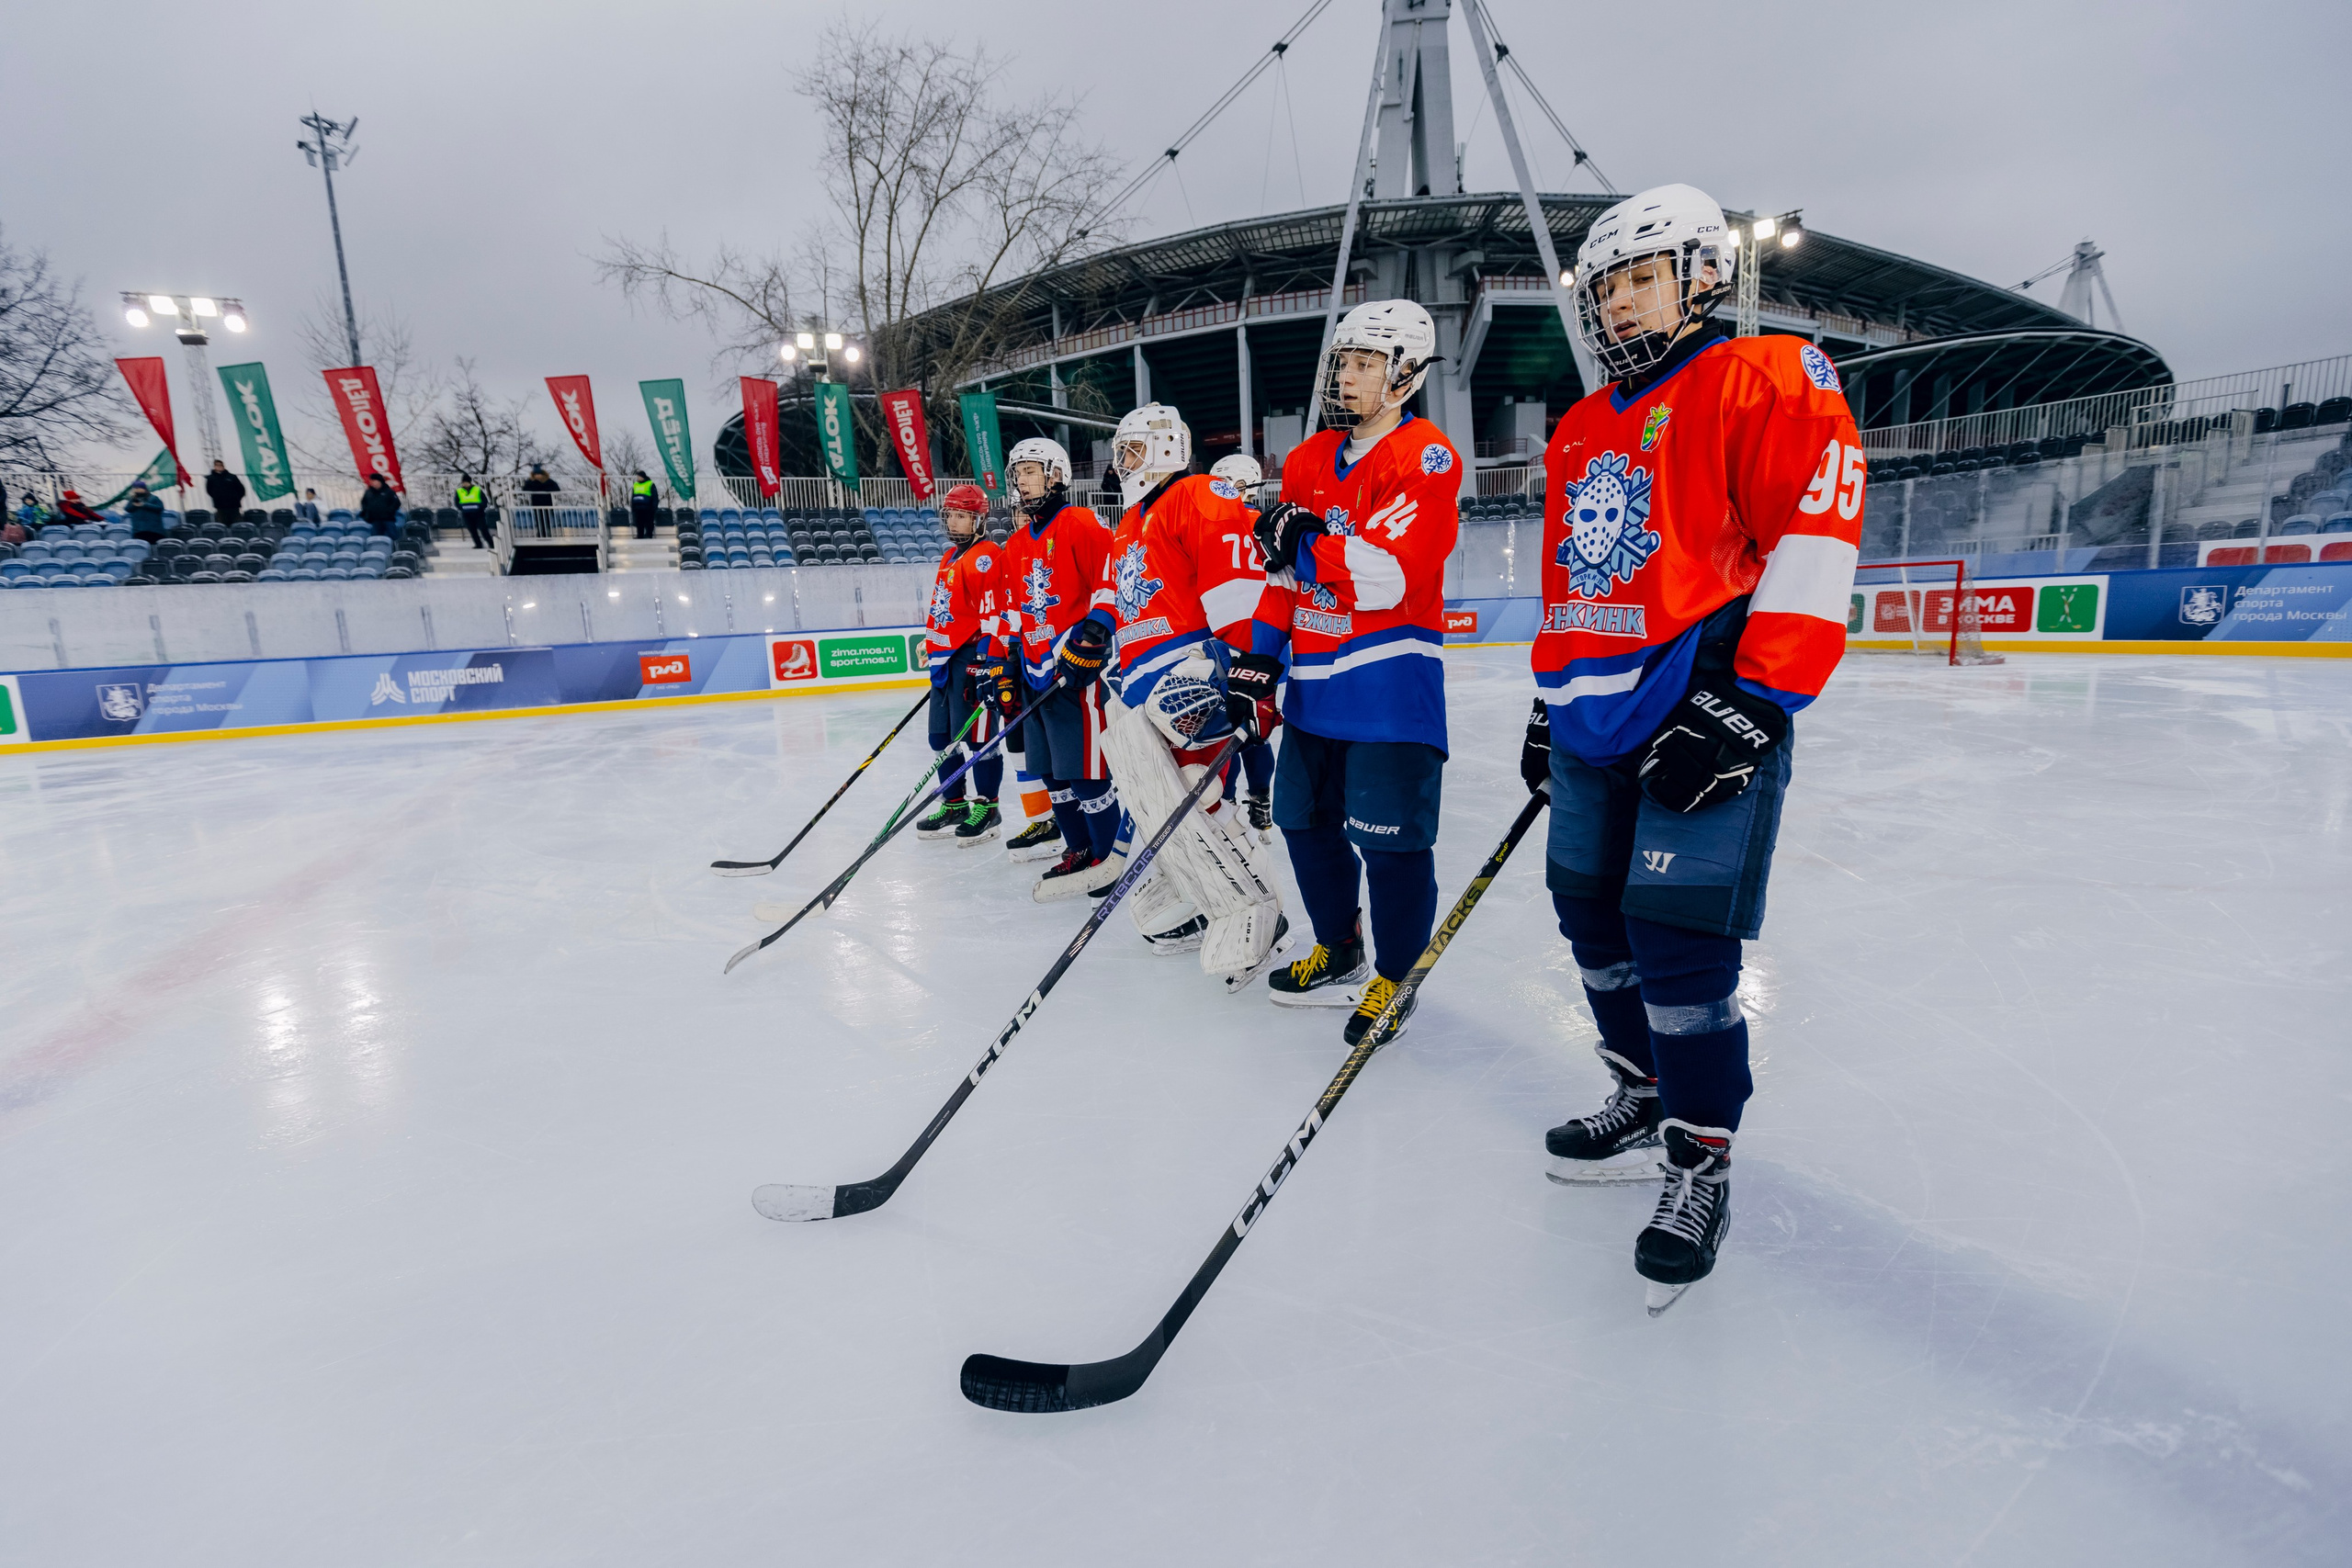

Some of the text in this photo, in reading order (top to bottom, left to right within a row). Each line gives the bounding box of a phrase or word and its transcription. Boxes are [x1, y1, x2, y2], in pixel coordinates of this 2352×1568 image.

[1589, 229, 1619, 249] CCM
[1697, 225, 1720, 233] CCM
[1799, 439, 1864, 520] 95
[1222, 533, 1265, 570] 72
[1576, 573, 1604, 586] ГОРКИ-10
[2233, 585, 2335, 597] Департамент
[1939, 595, 2016, 614] ЗИМА
[2233, 599, 2284, 610] спорта
[2233, 611, 2347, 623] города Москвы
[830, 656, 898, 668] sport.mos.ru
[831, 647, 895, 657] zima.mos.ru
[408, 663, 503, 686] МОСКОВСКИЙ
[411, 685, 456, 704] СПОРТ
[1690, 690, 1770, 750] AUER
[914, 750, 948, 794] BAUER
[1349, 816, 1401, 835] BAUER
[1196, 831, 1247, 897] TRUE
[1220, 829, 1269, 896] TRUE
[1097, 848, 1155, 922] RIBCOR
[1425, 884, 1483, 958] TACKS
[1396, 986, 1413, 1008] PRO
[968, 988, 1043, 1087] CCM
[1232, 1107, 1323, 1238] CCM
